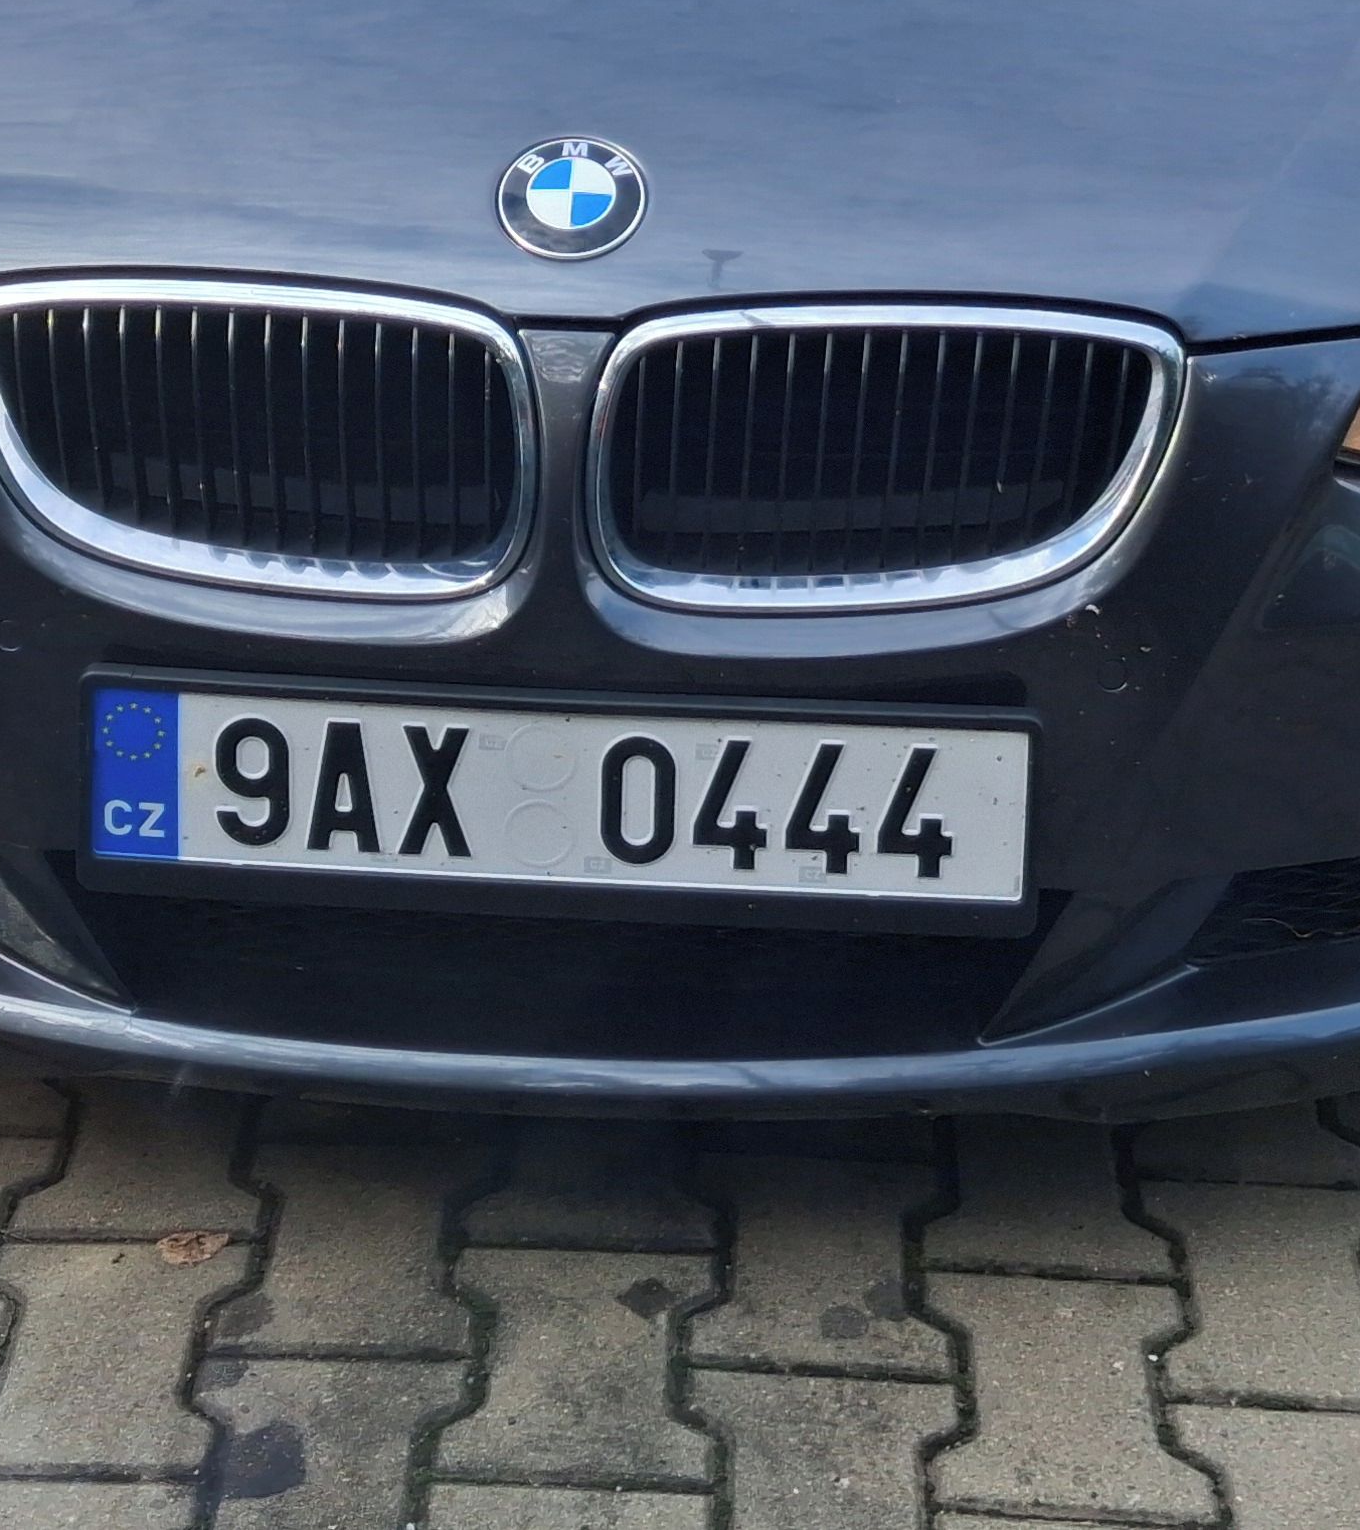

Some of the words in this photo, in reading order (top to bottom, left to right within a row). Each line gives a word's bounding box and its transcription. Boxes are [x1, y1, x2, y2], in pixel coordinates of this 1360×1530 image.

[516, 141, 634, 177] BMW
[103, 798, 166, 838] CZ
[214, 717, 472, 857] 9AX
[600, 734, 953, 879] 0444
